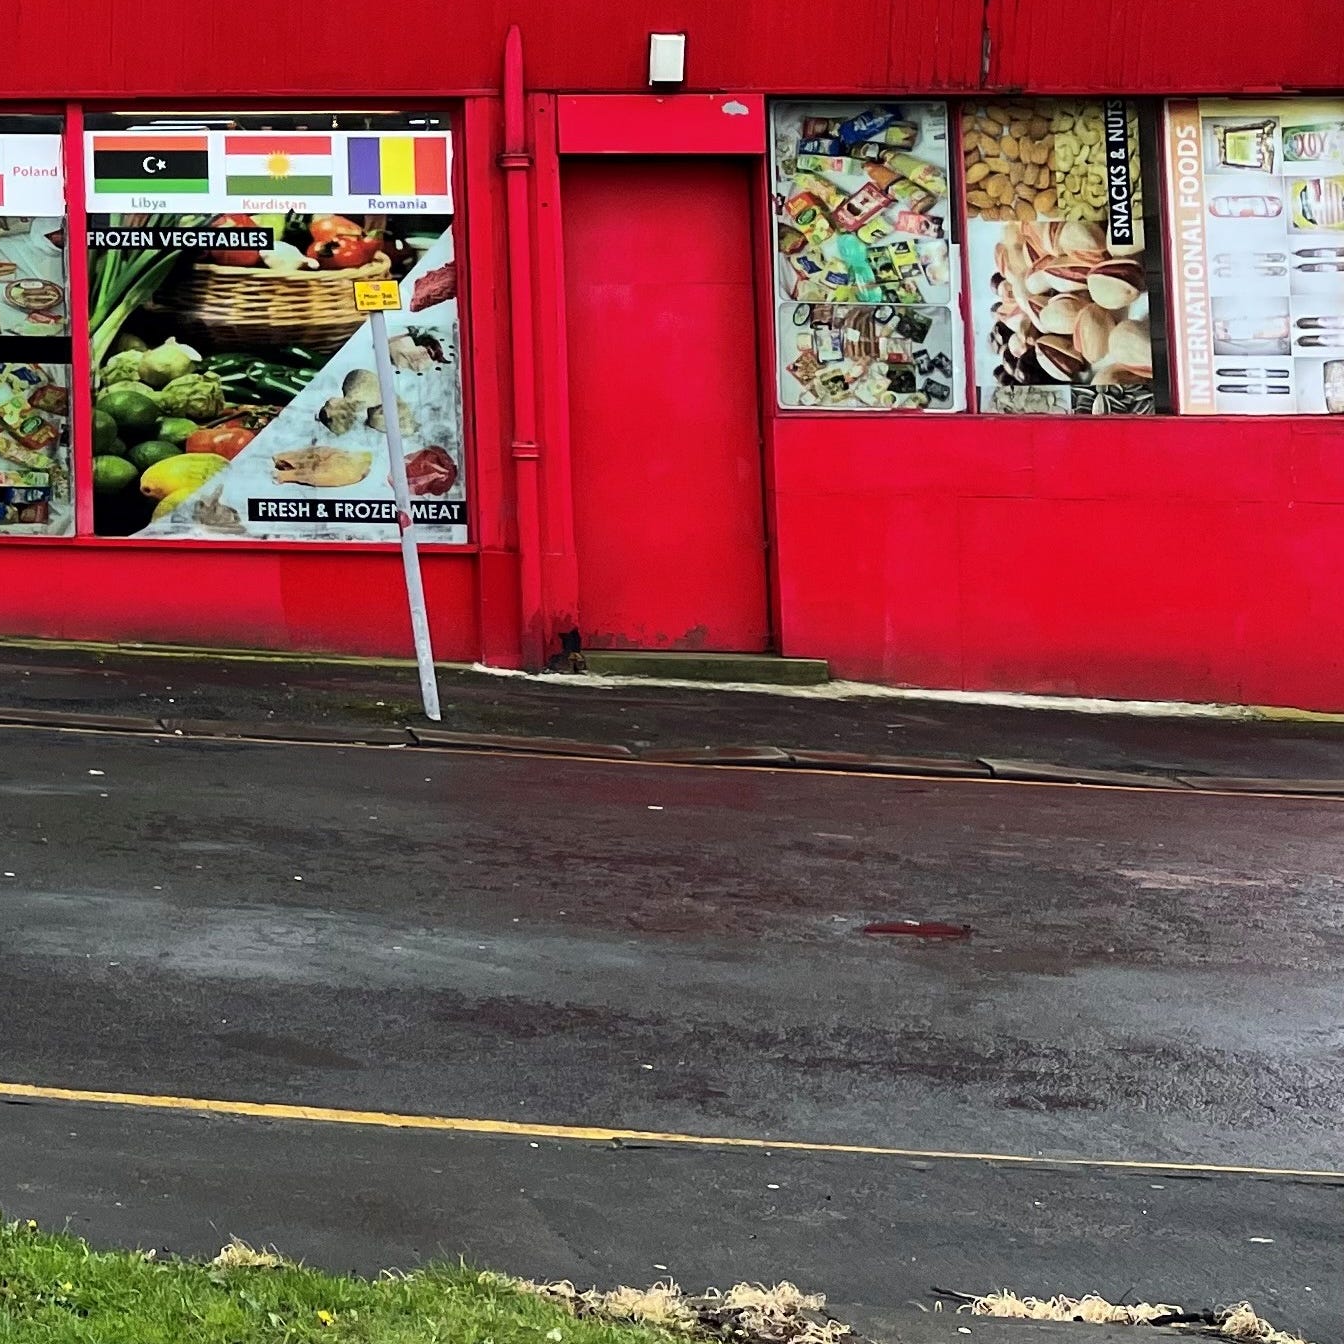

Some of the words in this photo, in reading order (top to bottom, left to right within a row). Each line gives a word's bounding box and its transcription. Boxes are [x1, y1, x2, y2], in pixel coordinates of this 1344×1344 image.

[1106, 99, 1124, 143] NUTS
[1110, 147, 1126, 160] &
[12, 165, 58, 178] Poland
[1176, 125, 1201, 206] FOODS
[130, 197, 167, 210] Libya
[242, 198, 307, 211] Kurdistan
[367, 198, 428, 210] Romania
[1110, 165, 1130, 238] SNACKS
[87, 232, 154, 247] FROZEN
[160, 231, 269, 247] VEGETABLES
[1182, 211, 1213, 405] INTERNATIONAL
[258, 501, 310, 518] FRESH
[316, 503, 329, 518] &
[411, 504, 461, 520] MEAT
